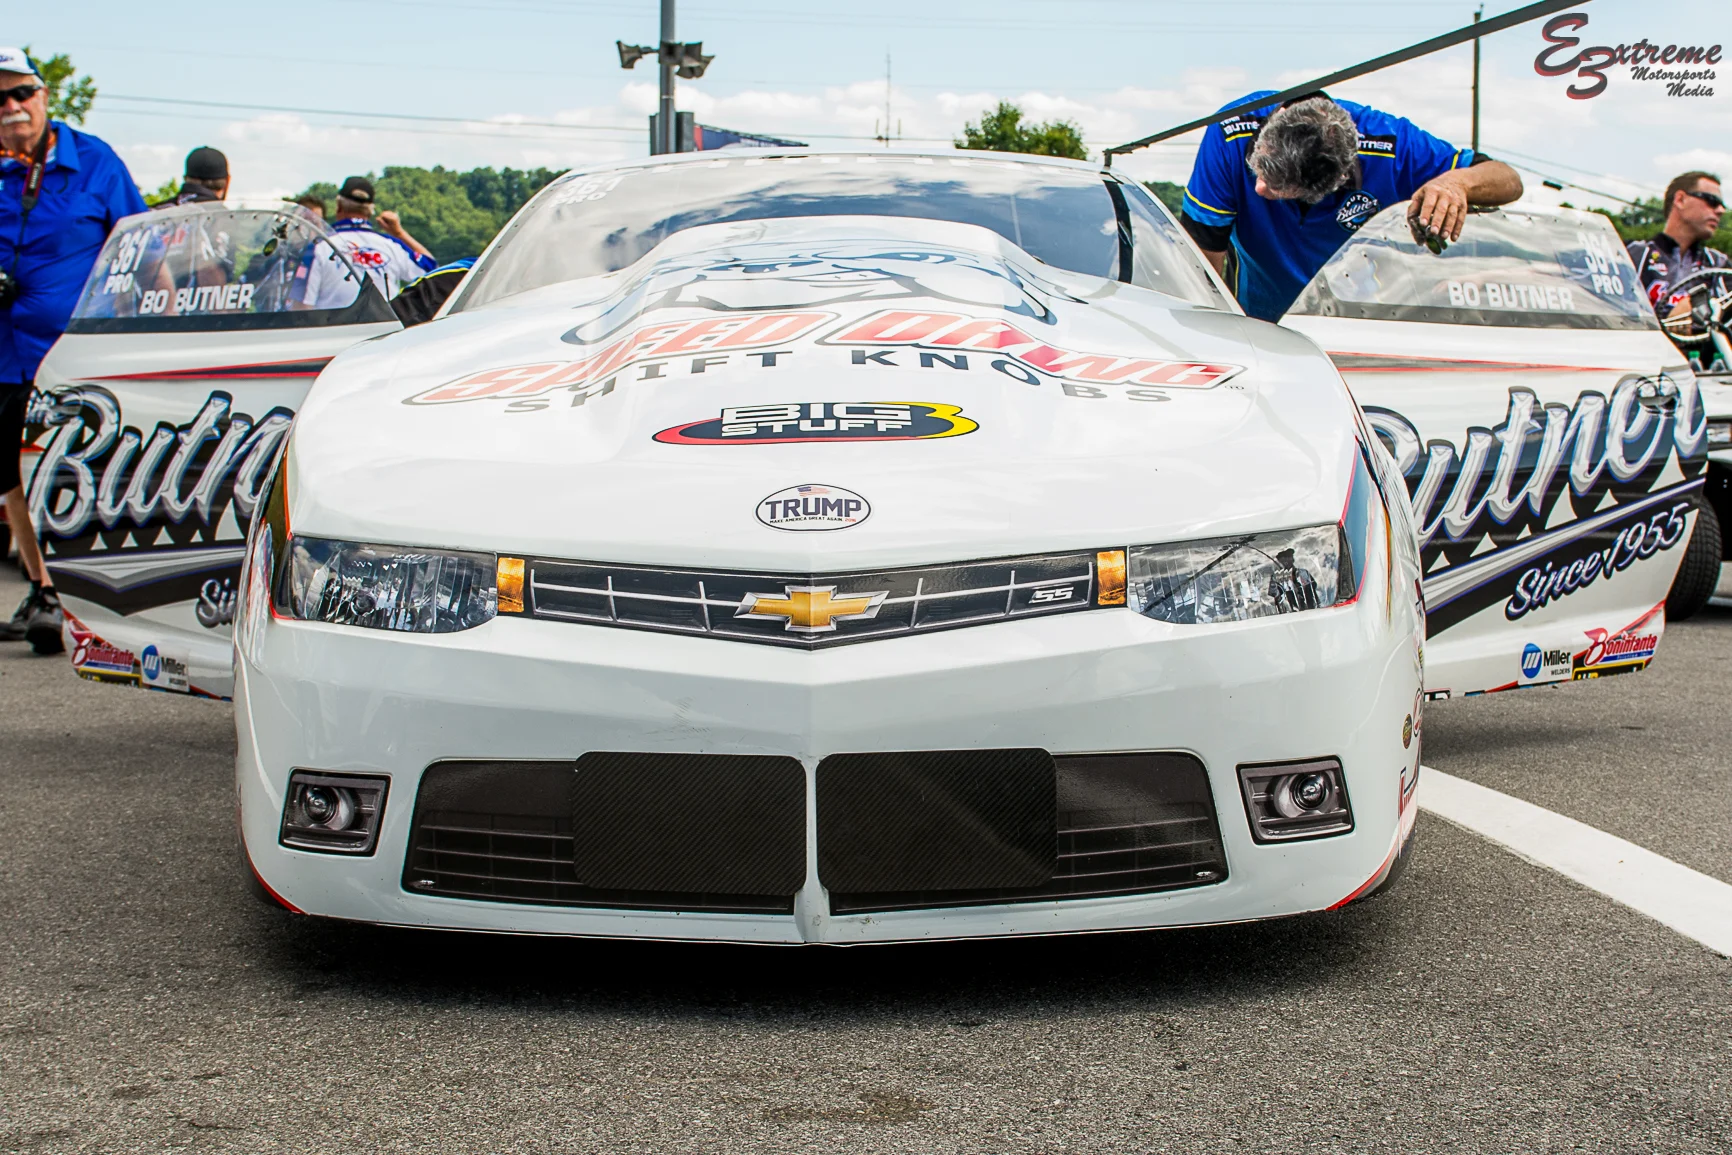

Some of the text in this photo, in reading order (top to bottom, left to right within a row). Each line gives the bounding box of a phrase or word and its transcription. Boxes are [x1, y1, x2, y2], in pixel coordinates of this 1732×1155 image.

[1346, 194, 1369, 207] AUTO
[110, 229, 152, 274] 361
[1576, 231, 1620, 276] 361
[103, 272, 134, 295] PRO
[1448, 280, 1575, 310] BO BUTNER
[1591, 274, 1624, 296] PRO
[139, 283, 255, 315] BO BUTNER
[421, 309, 1234, 402] SPEED DAWG
[503, 349, 1172, 414] SHIFT KNOBS
[721, 402, 912, 425] BIG
[721, 419, 911, 437] STUFF
[765, 497, 862, 520] TRUMP
[1506, 502, 1690, 610] Since 1955
[1029, 586, 1074, 604] SS
[161, 656, 187, 676] Miller
[1543, 649, 1571, 667] Miller
[1551, 667, 1571, 676] WELDERS
